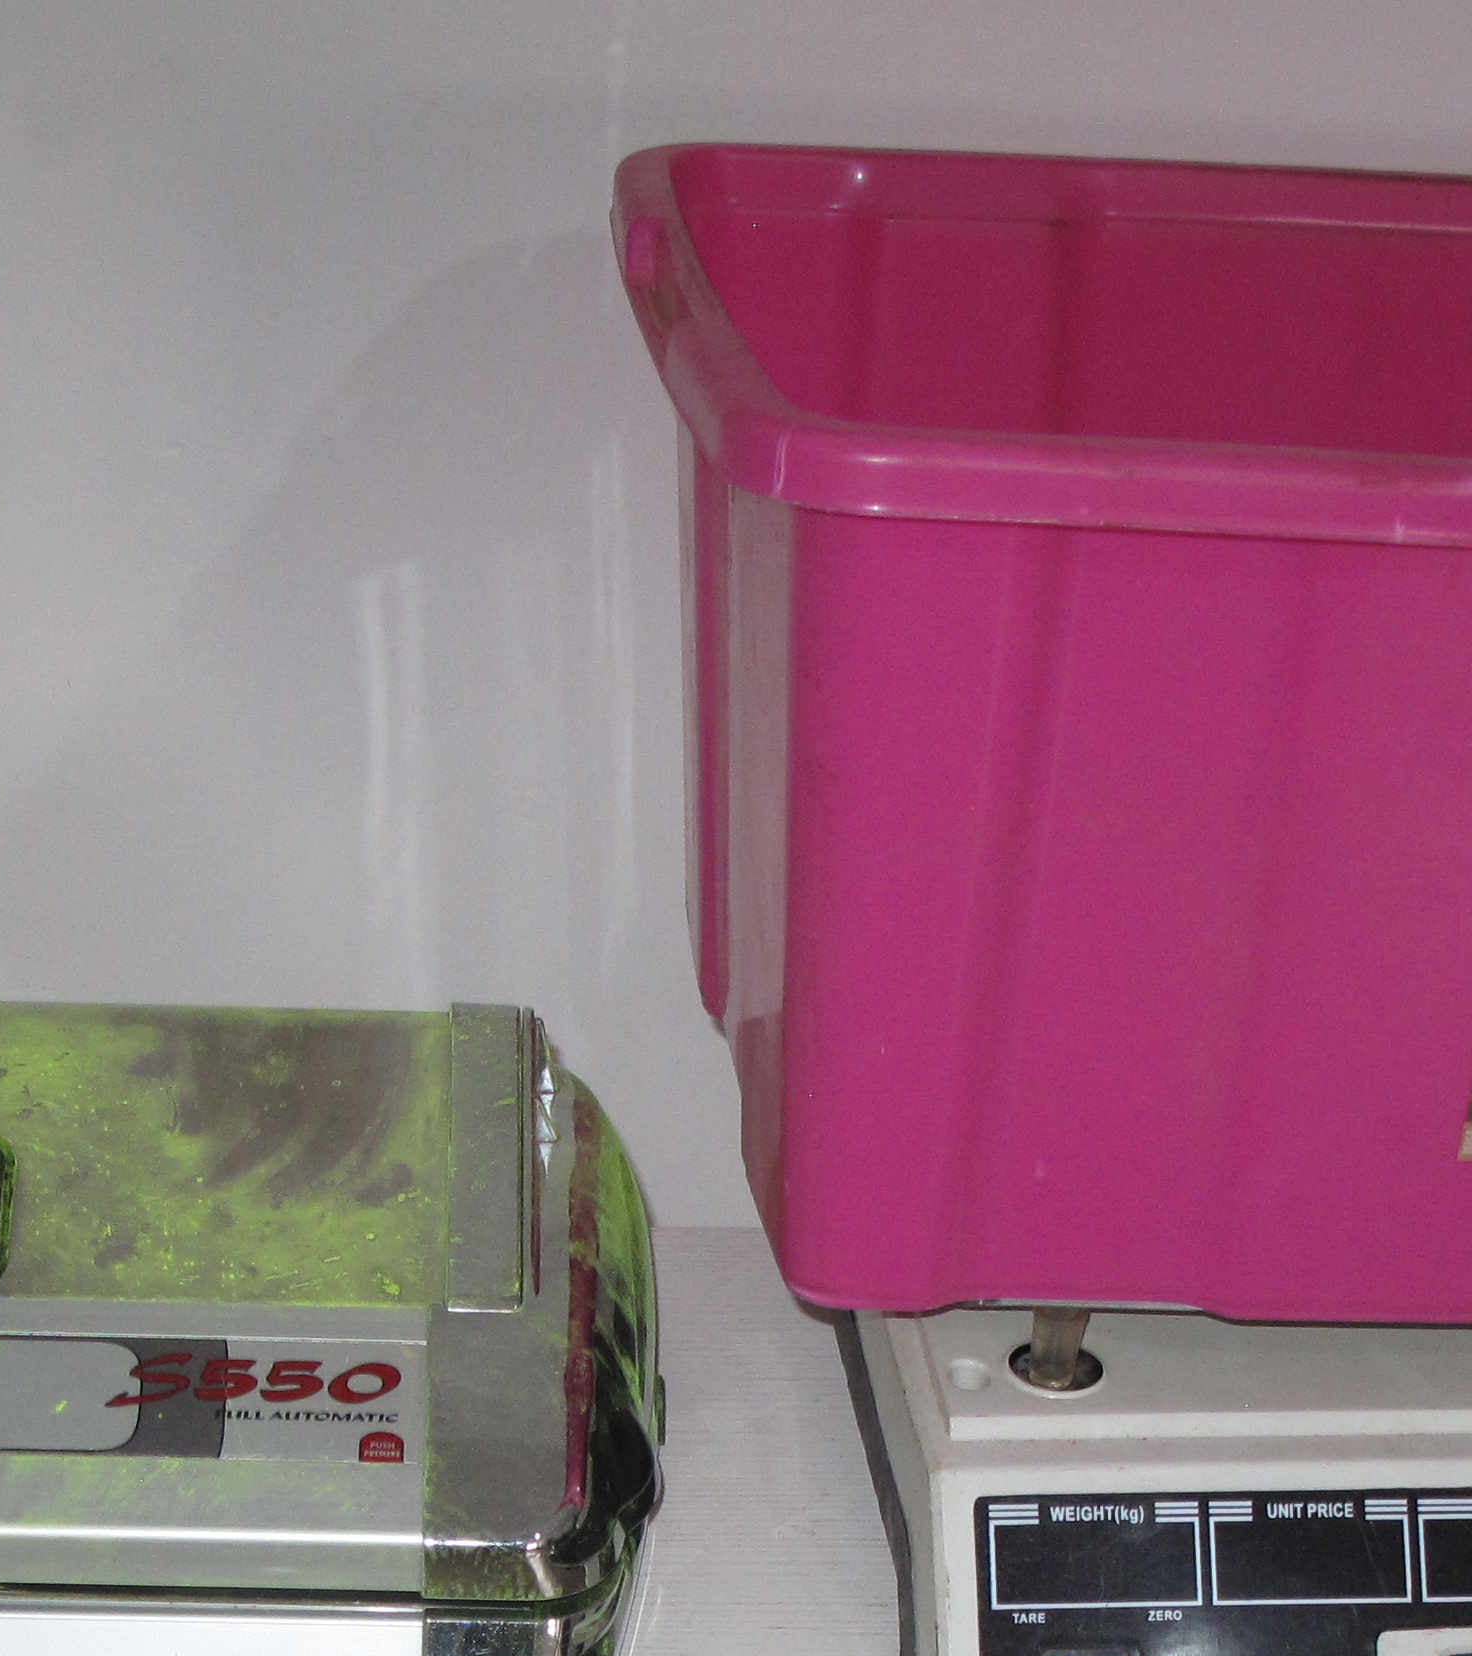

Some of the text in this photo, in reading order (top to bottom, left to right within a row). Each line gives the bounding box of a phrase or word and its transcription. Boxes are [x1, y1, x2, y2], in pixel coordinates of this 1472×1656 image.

[105, 1352, 402, 1408] S550
[214, 1409, 399, 1424] FULL AUTOMATIC
[1049, 1505, 1146, 1525] WEIGHT(kg)
[1266, 1501, 1355, 1519] UNIT PRICE
[1011, 1611, 1046, 1625] TARE
[1147, 1609, 1183, 1623] ZERO
